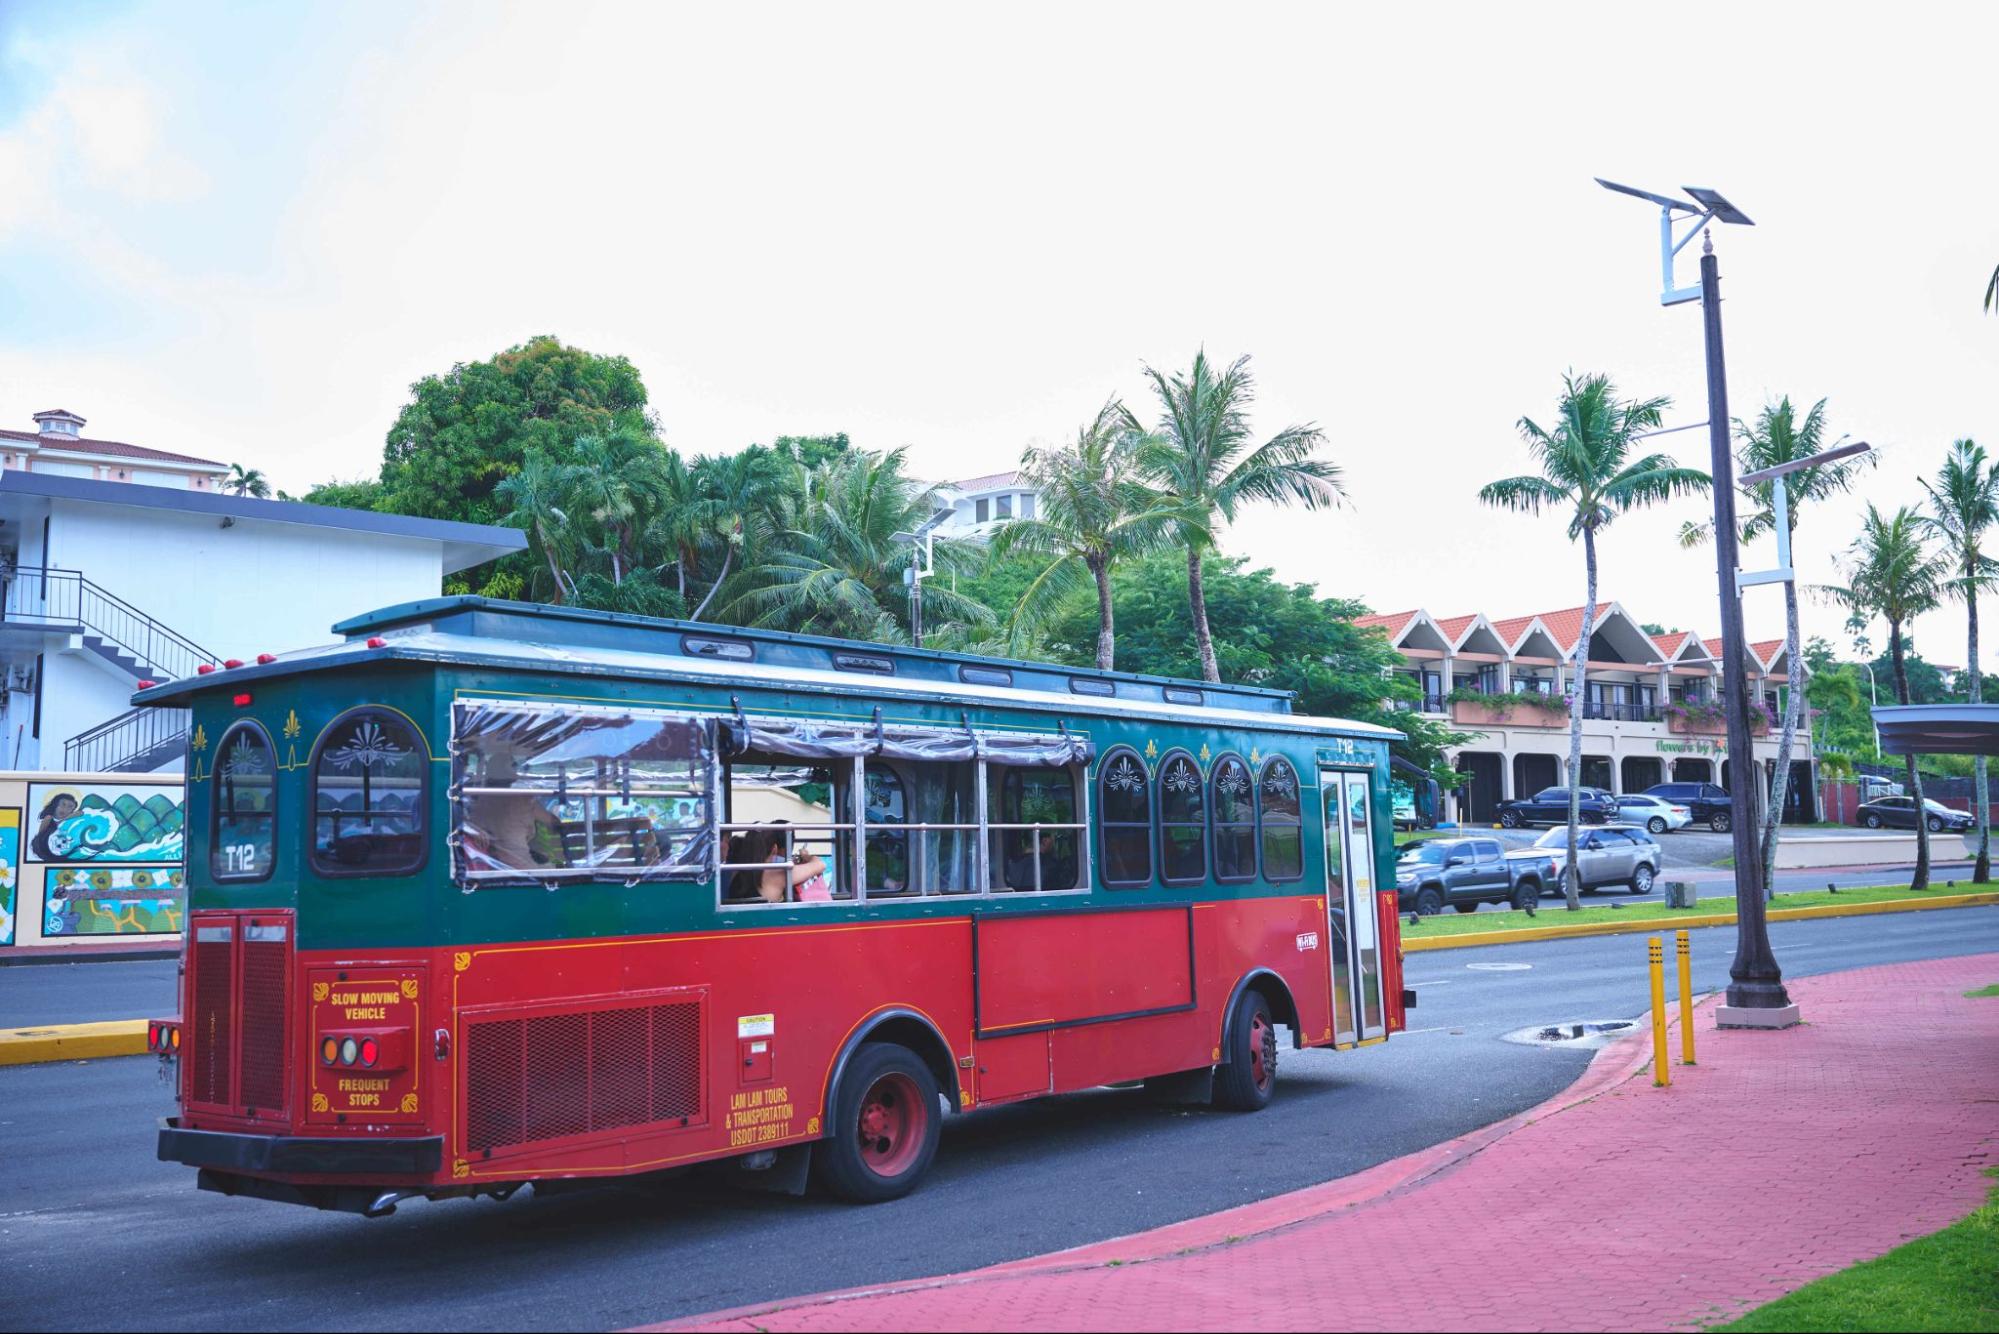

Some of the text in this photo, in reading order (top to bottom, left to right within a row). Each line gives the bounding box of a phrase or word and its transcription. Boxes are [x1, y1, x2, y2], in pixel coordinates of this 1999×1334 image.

[1336, 737, 1354, 754] T12
[1655, 739, 1695, 753] flowers
[1697, 741, 1710, 756] by
[225, 844, 255, 871] T12
[331, 992, 400, 1006] SLOW MOVING
[345, 1007, 386, 1020] VEHICLE
[338, 1079, 391, 1092] FREQUENT
[349, 1093, 380, 1106] STOPS
[731, 1086, 788, 1110] LAM LAM TOURS
[726, 1103, 794, 1129] & TRANSPORTATION
[731, 1121, 790, 1146] USDOT 2389111
